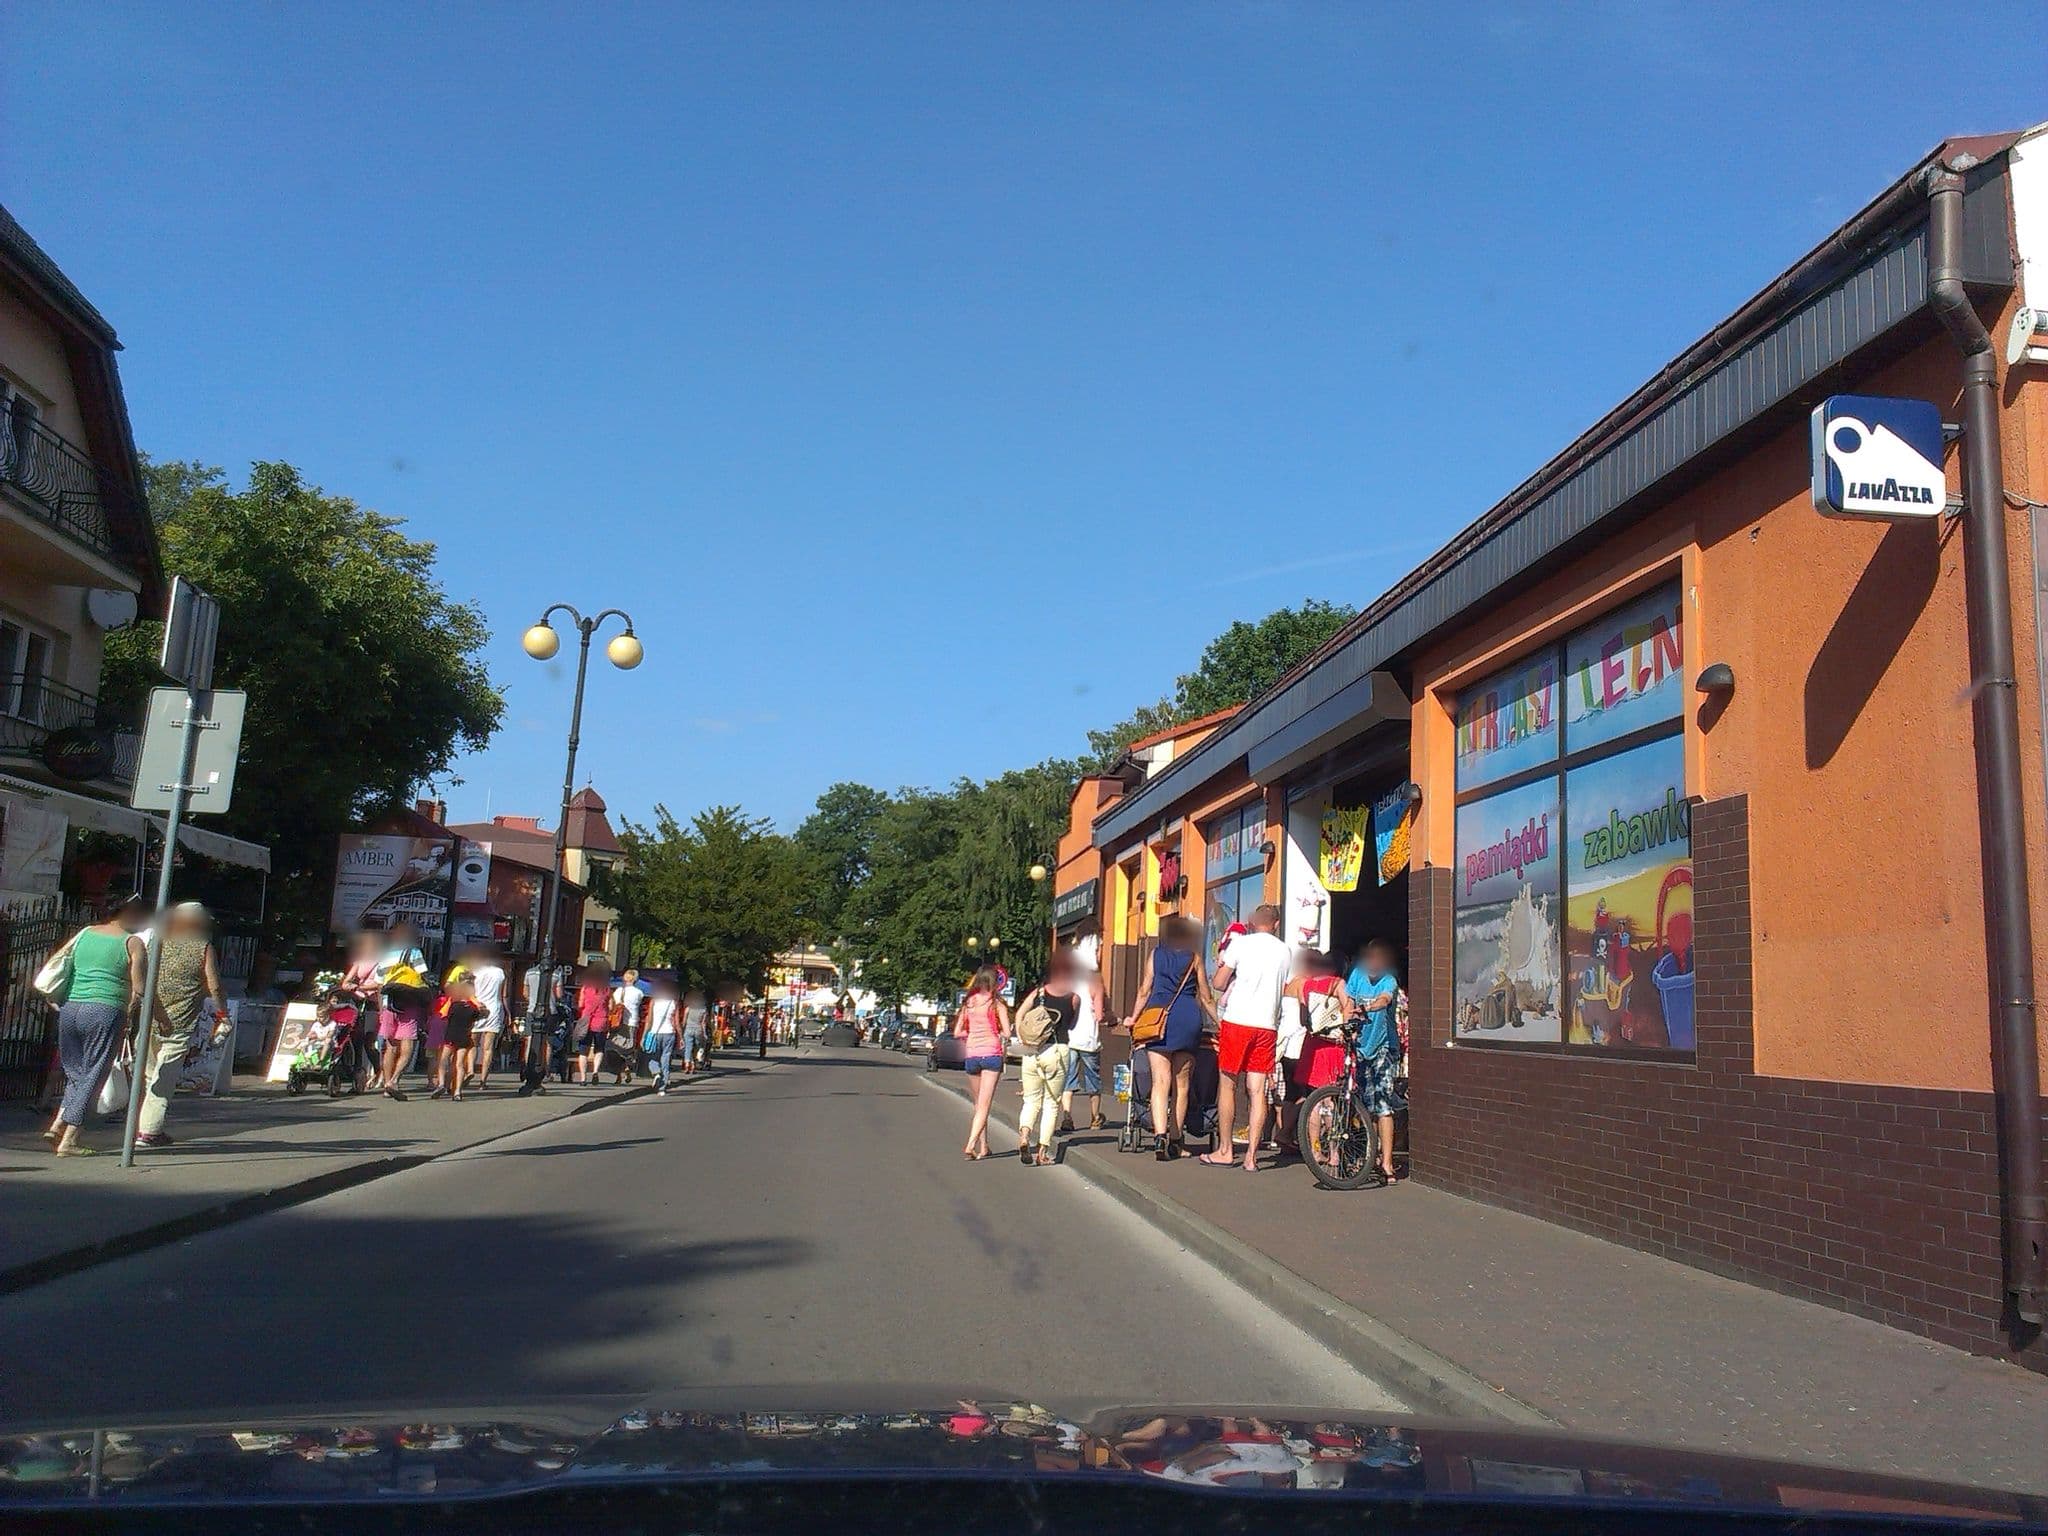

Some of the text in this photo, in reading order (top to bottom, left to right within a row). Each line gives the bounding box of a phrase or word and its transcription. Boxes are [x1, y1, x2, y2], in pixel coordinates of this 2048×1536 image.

[1848, 478, 1934, 505] LAVAZZA
[343, 850, 395, 868] AMBER
[1465, 812, 1549, 897] pamiątki
